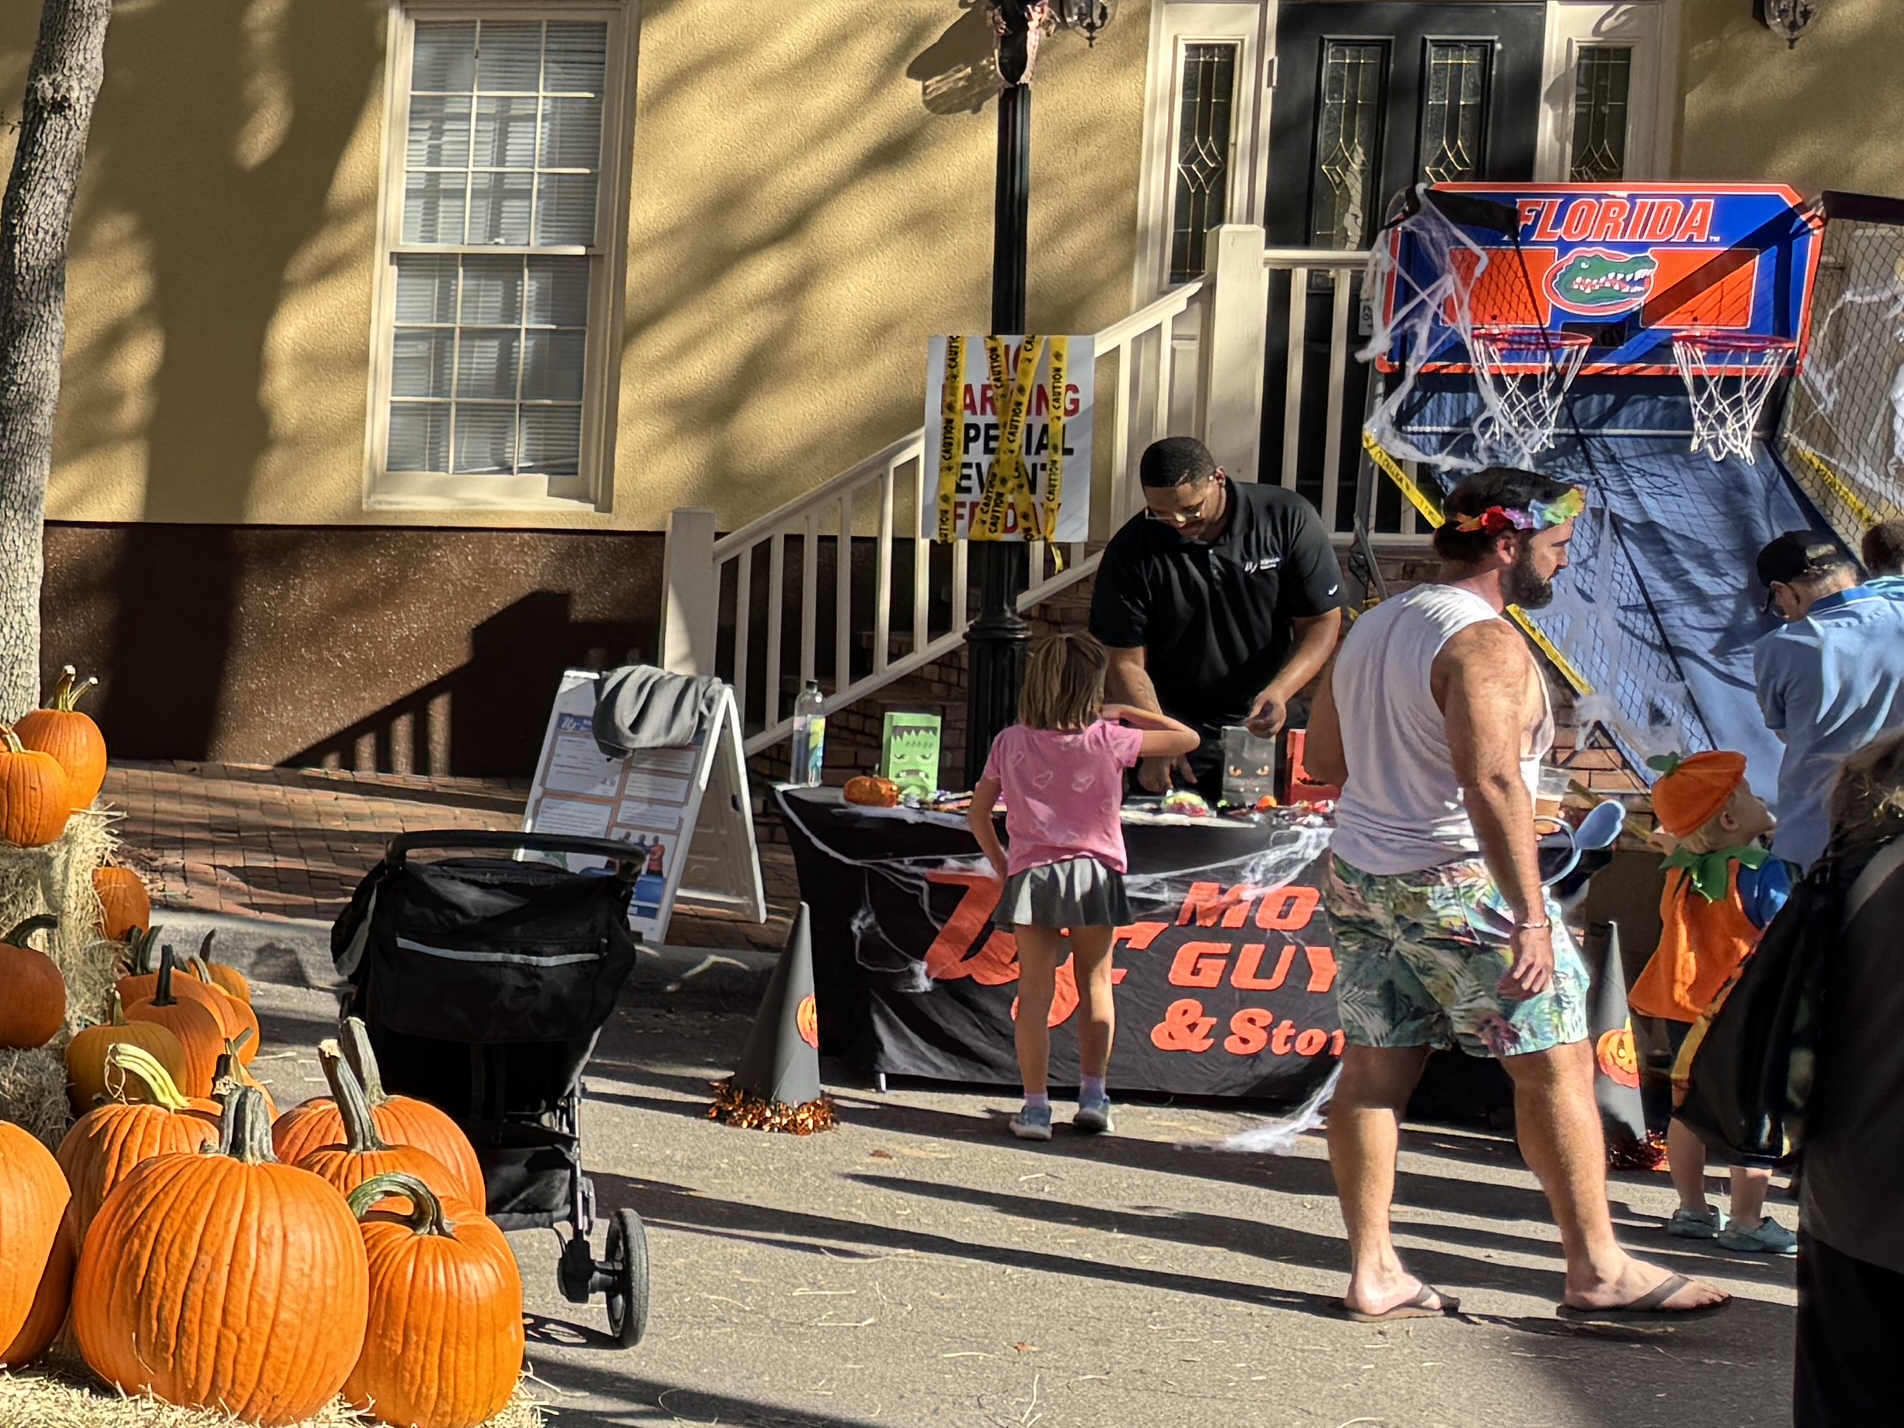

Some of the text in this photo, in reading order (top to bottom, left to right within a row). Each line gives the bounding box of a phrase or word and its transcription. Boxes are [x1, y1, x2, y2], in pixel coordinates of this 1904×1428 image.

[1504, 198, 1715, 243] FLORIDA
[1050, 366, 1063, 411] CAUTION
[1151, 998, 1218, 1053] &
